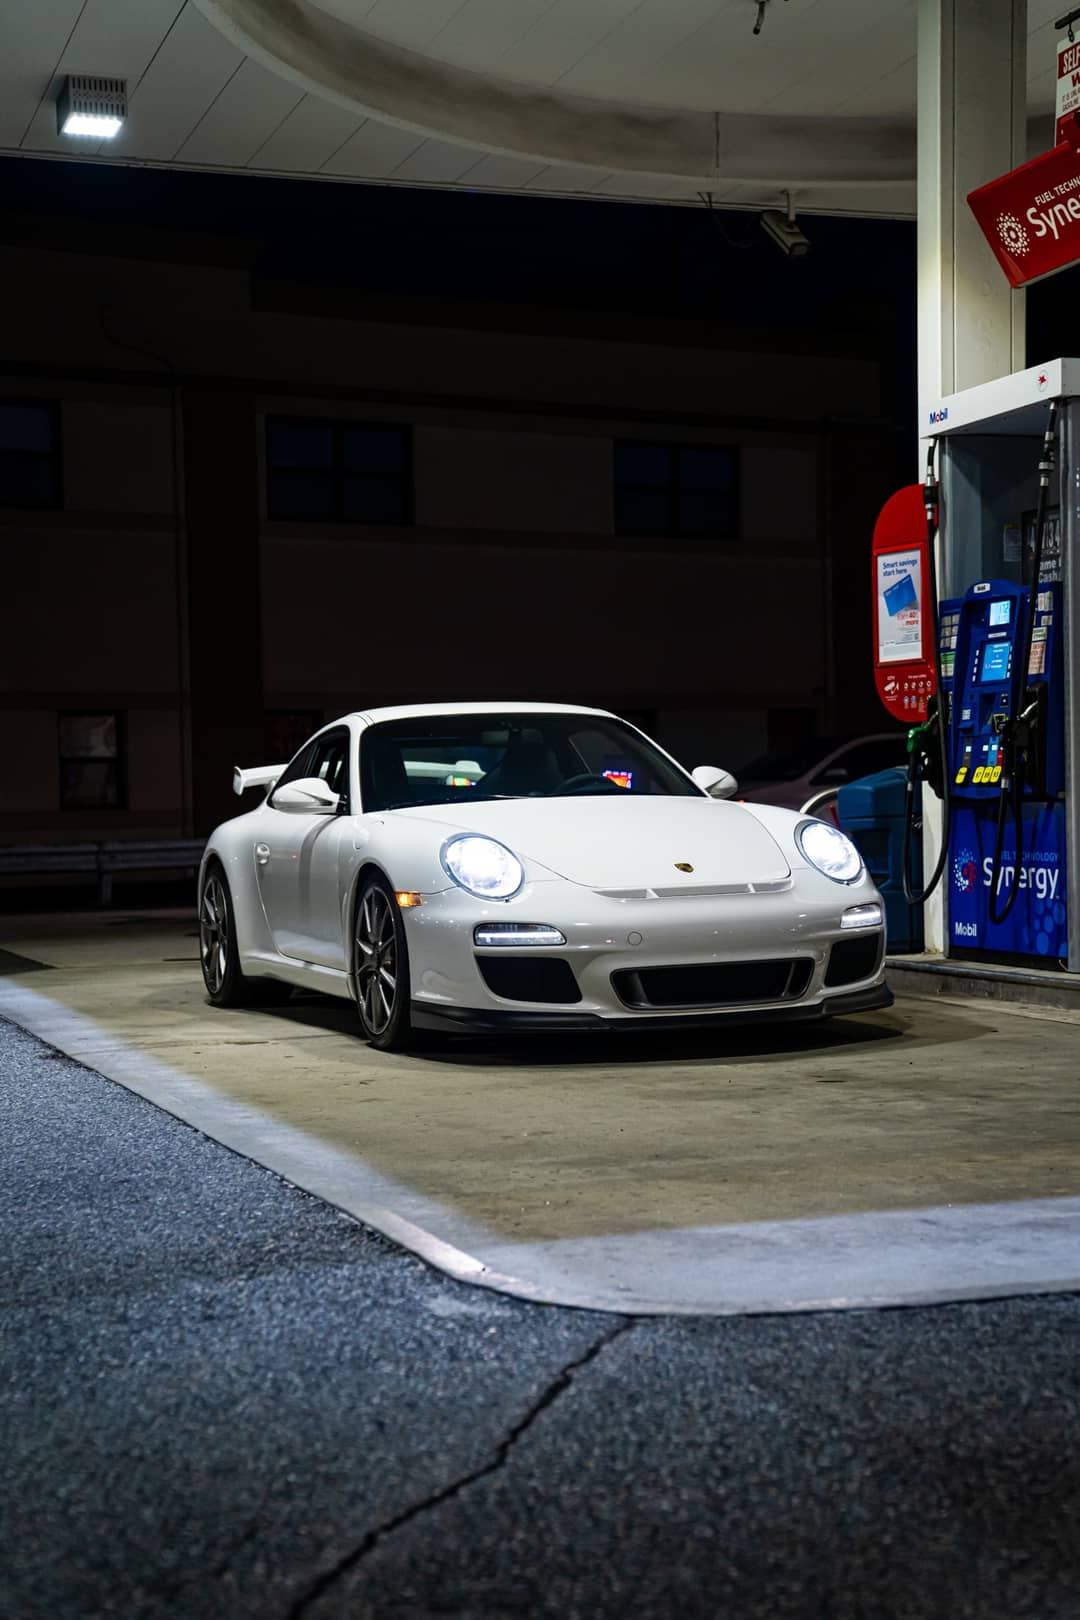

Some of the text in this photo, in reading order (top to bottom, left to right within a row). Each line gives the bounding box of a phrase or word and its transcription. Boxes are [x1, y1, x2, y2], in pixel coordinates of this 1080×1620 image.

[1034, 190, 1056, 206] FUEL
[1026, 194, 1080, 240] Syne
[929, 407, 948, 424] Mobil
[882, 559, 918, 569] Smart savings
[1040, 560, 1057, 570] ame
[983, 857, 1059, 899] Synergy
[955, 921, 977, 937] Mobil
